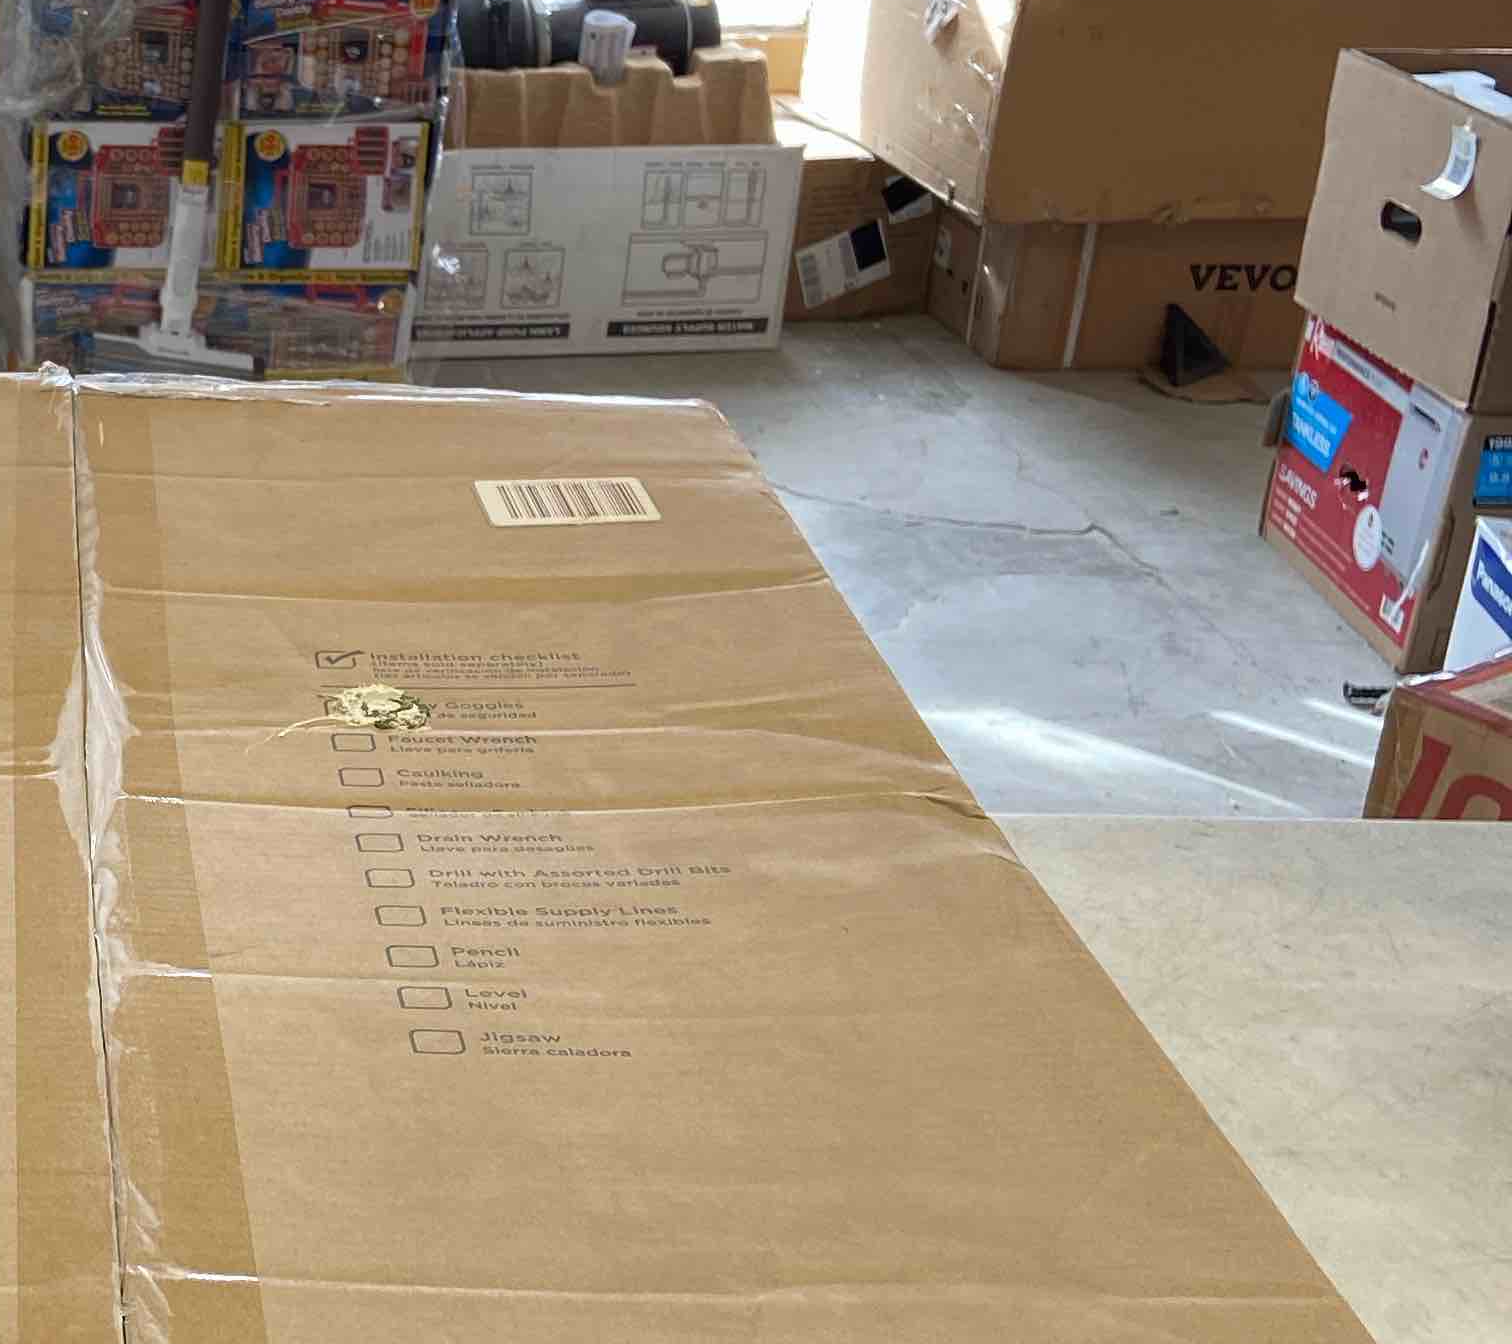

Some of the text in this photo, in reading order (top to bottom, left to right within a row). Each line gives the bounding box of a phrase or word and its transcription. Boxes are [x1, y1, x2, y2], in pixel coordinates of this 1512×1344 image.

[370, 651, 582, 662] Installation checklist
[389, 734, 538, 744] Faucet Wrench
[396, 768, 484, 779] Caulking
[417, 833, 563, 842] Drain Wrench
[428, 865, 732, 878] Drill with Assorted Drill Bits
[440, 905, 681, 918] Flexible Supply Lines
[451, 946, 520, 957] Pencil
[464, 988, 528, 999] Level
[468, 1001, 518, 1011] Nivel
[479, 1032, 561, 1044] Jigsaw
[482, 1046, 632, 1057] Sierra caladora
